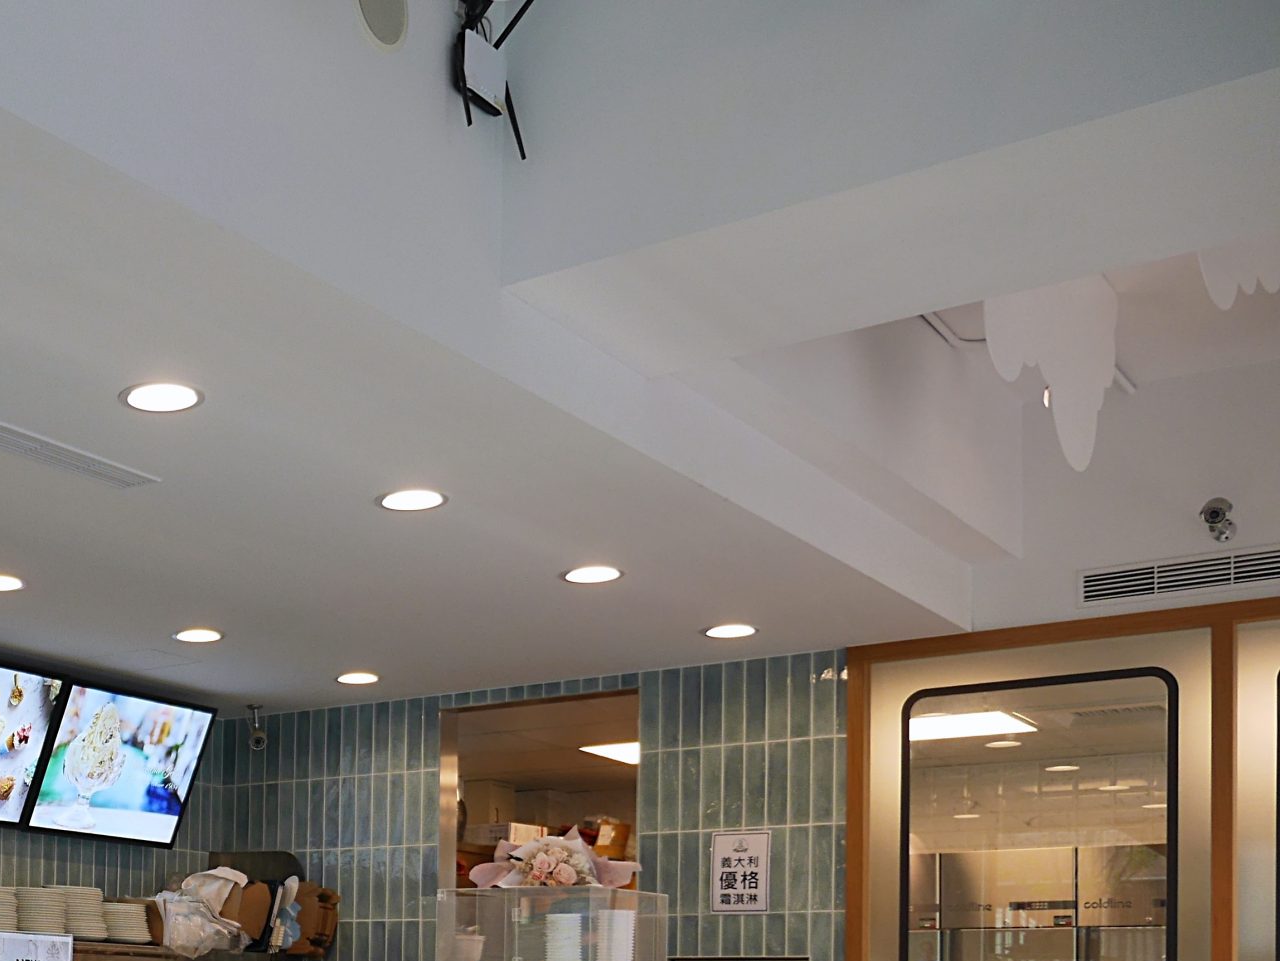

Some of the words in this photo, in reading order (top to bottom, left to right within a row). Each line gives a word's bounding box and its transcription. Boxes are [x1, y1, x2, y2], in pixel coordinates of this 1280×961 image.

[721, 856, 759, 868] 義大利
[719, 871, 759, 890] 優格
[720, 894, 758, 905] 霜淇淋
